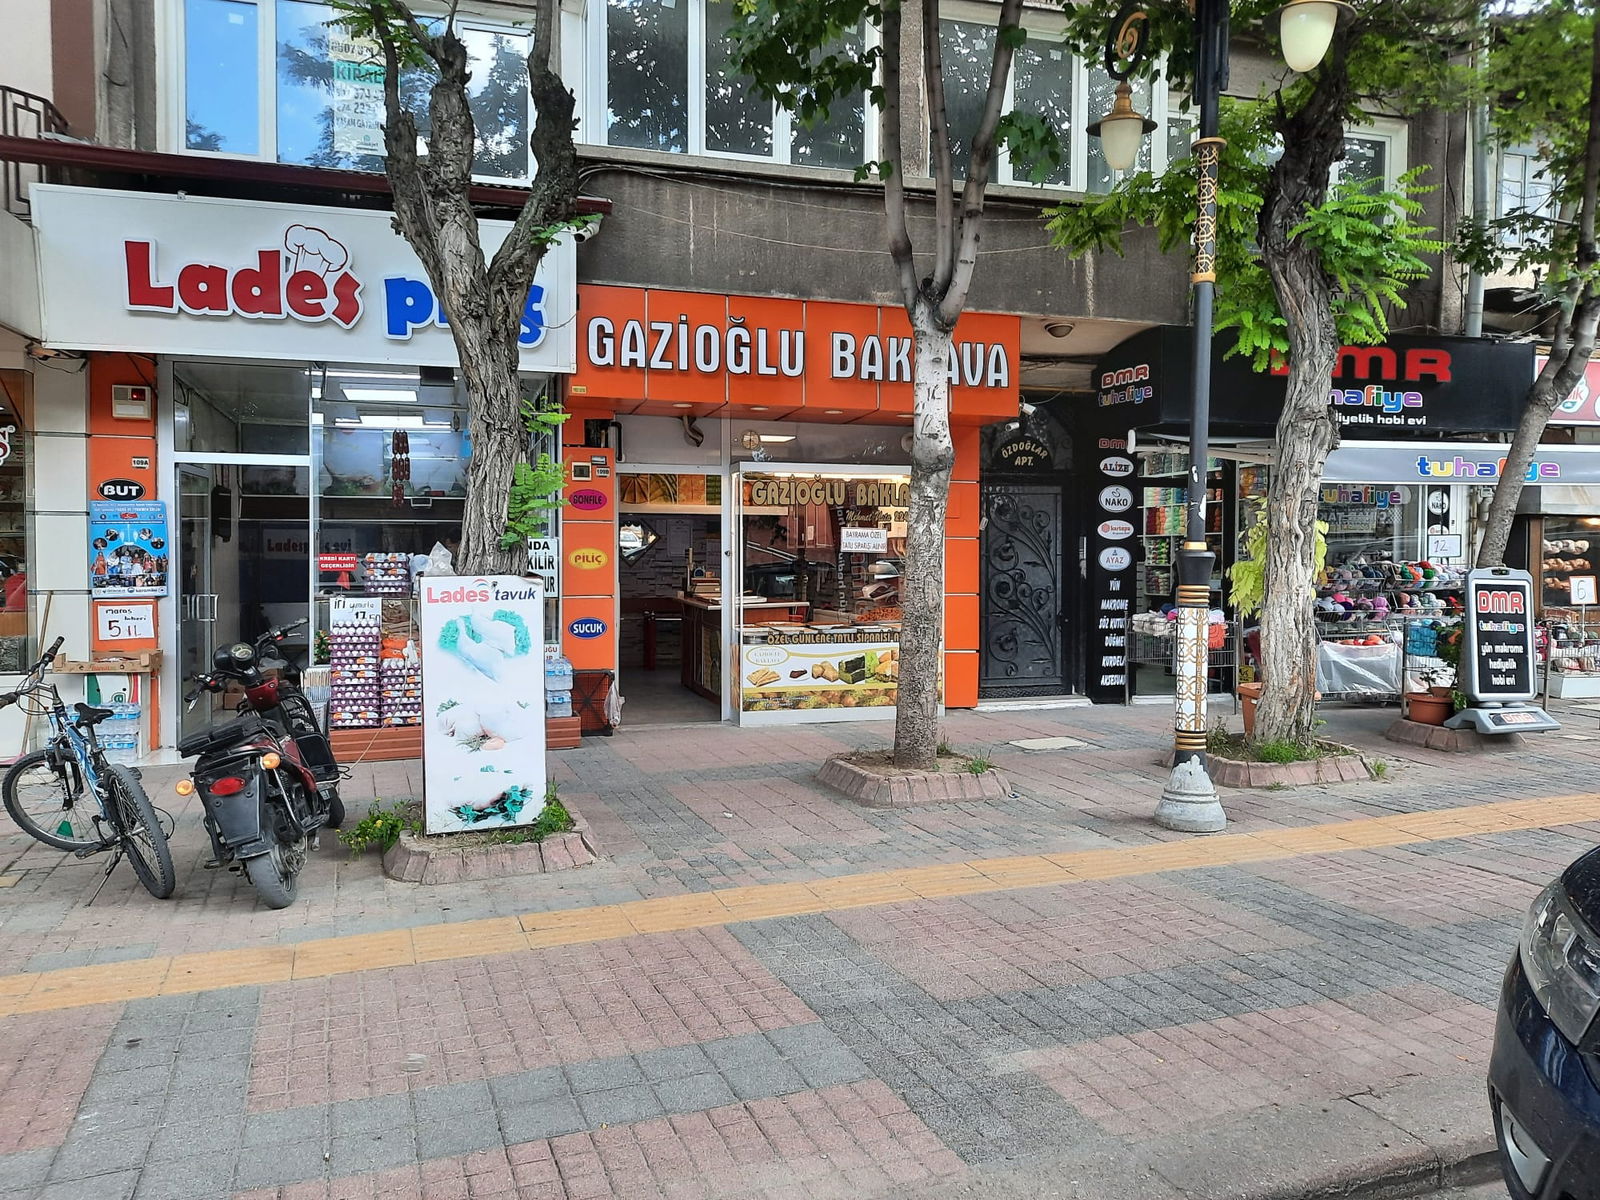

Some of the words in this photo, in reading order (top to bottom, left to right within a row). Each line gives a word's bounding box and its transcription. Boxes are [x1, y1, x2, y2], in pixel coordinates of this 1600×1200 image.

[124, 240, 361, 326] Lades
[384, 277, 545, 344] ps
[587, 313, 806, 378] GAZİOĞLU
[830, 331, 1009, 388] BAKAVA
[1102, 364, 1149, 389] DMR
[1098, 385, 1152, 407] tuhafiye
[1377, 413, 1405, 425] hobi
[1407, 415, 1426, 426] evi
[1001, 440, 1048, 460] ÖZDOĞLAR
[1098, 438, 1128, 449] DM
[132, 459, 149, 467] 109A
[1014, 456, 1034, 466] APT.
[103, 485, 140, 497] BUT
[751, 474, 846, 506] GAZİOĞLU
[855, 481, 911, 507] BAKLA
[1105, 498, 1128, 506] NAKO
[1434, 539, 1449, 553] 12
[574, 553, 602, 565] PİLİÇ
[1105, 556, 1124, 564] AYAZ
[427, 586, 490, 604] Lades
[494, 587, 536, 601] tavuk
[1577, 579, 1587, 600] 6
[1477, 590, 1524, 614] DMR
[108, 620, 122, 638] 5
[1479, 621, 1524, 634] tuhafiye
[767, 631, 788, 645] ÖZEL
[1491, 674, 1506, 686] hobi
